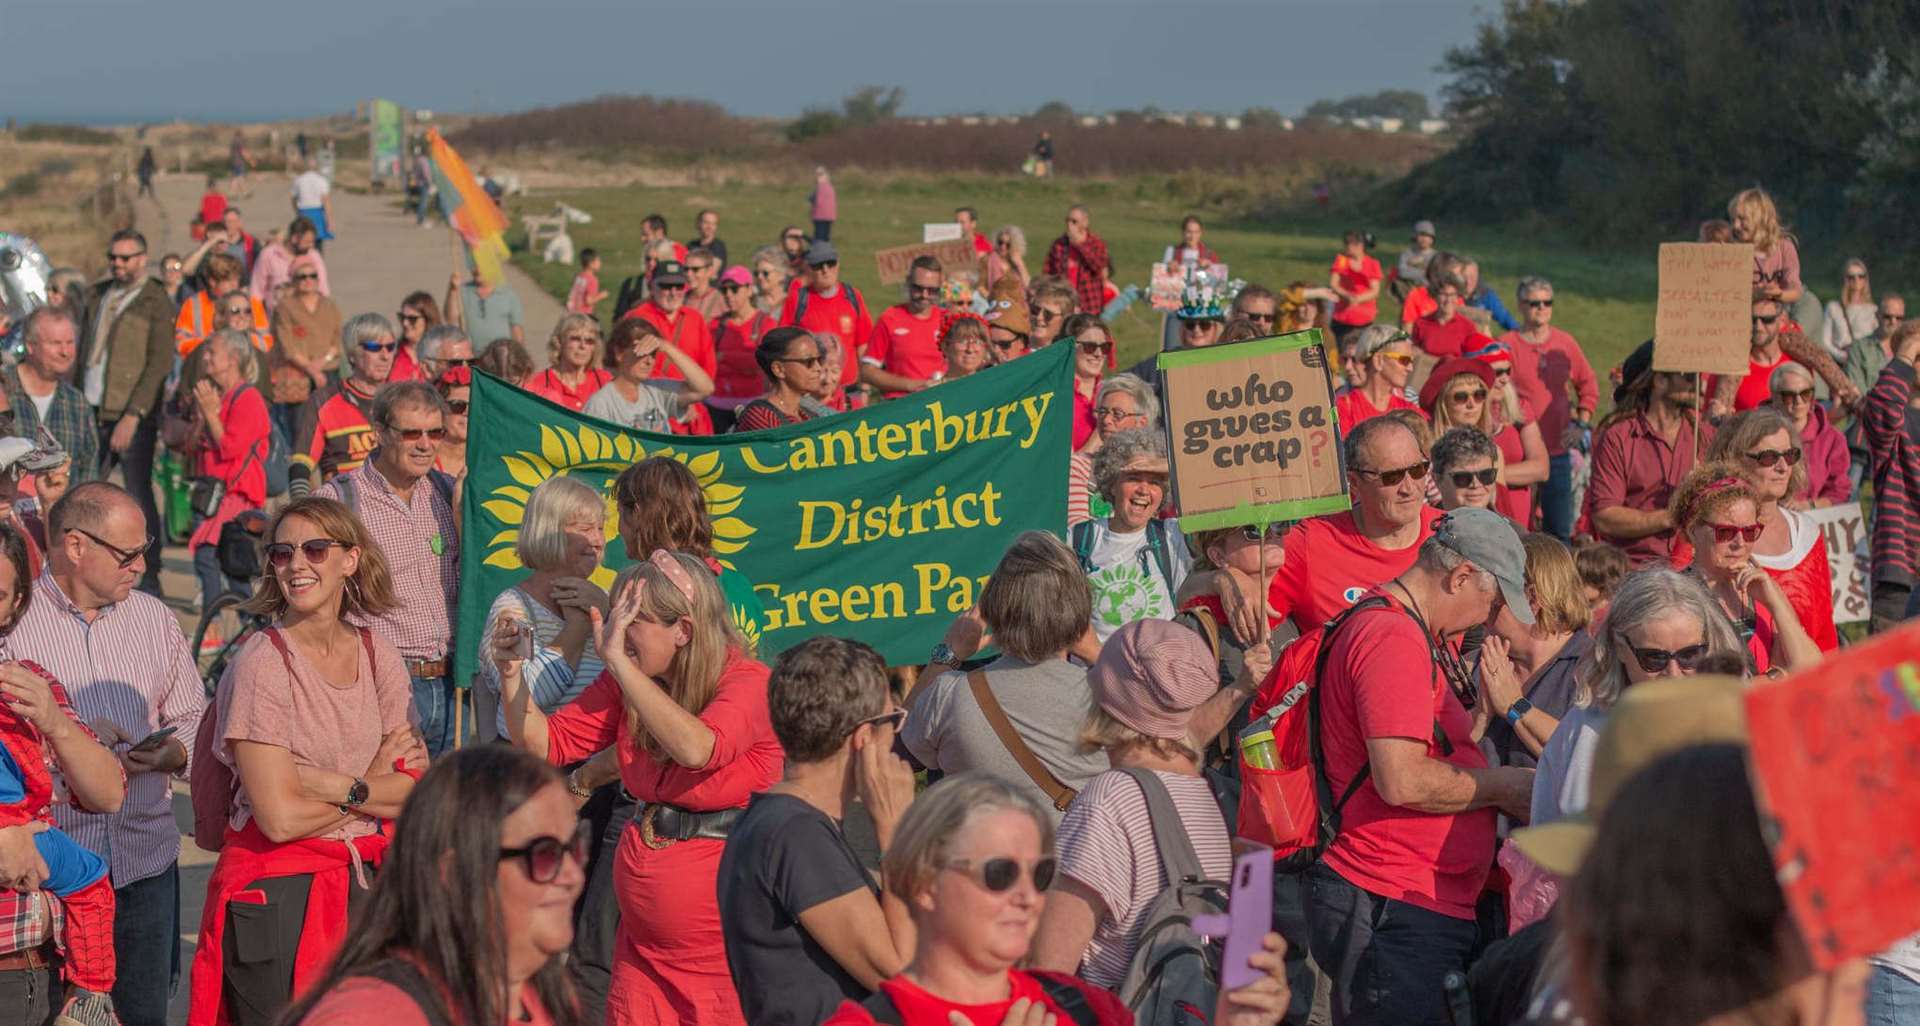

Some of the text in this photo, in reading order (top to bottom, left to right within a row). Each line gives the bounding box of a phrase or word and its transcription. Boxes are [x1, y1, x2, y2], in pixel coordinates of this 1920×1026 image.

[1206, 373, 1293, 411] who
[1183, 405, 1326, 455] gives a
[1213, 437, 1302, 469] crap
[794, 481, 1002, 551] District
[1819, 516, 1861, 554] HY
[752, 581, 908, 632] Green
